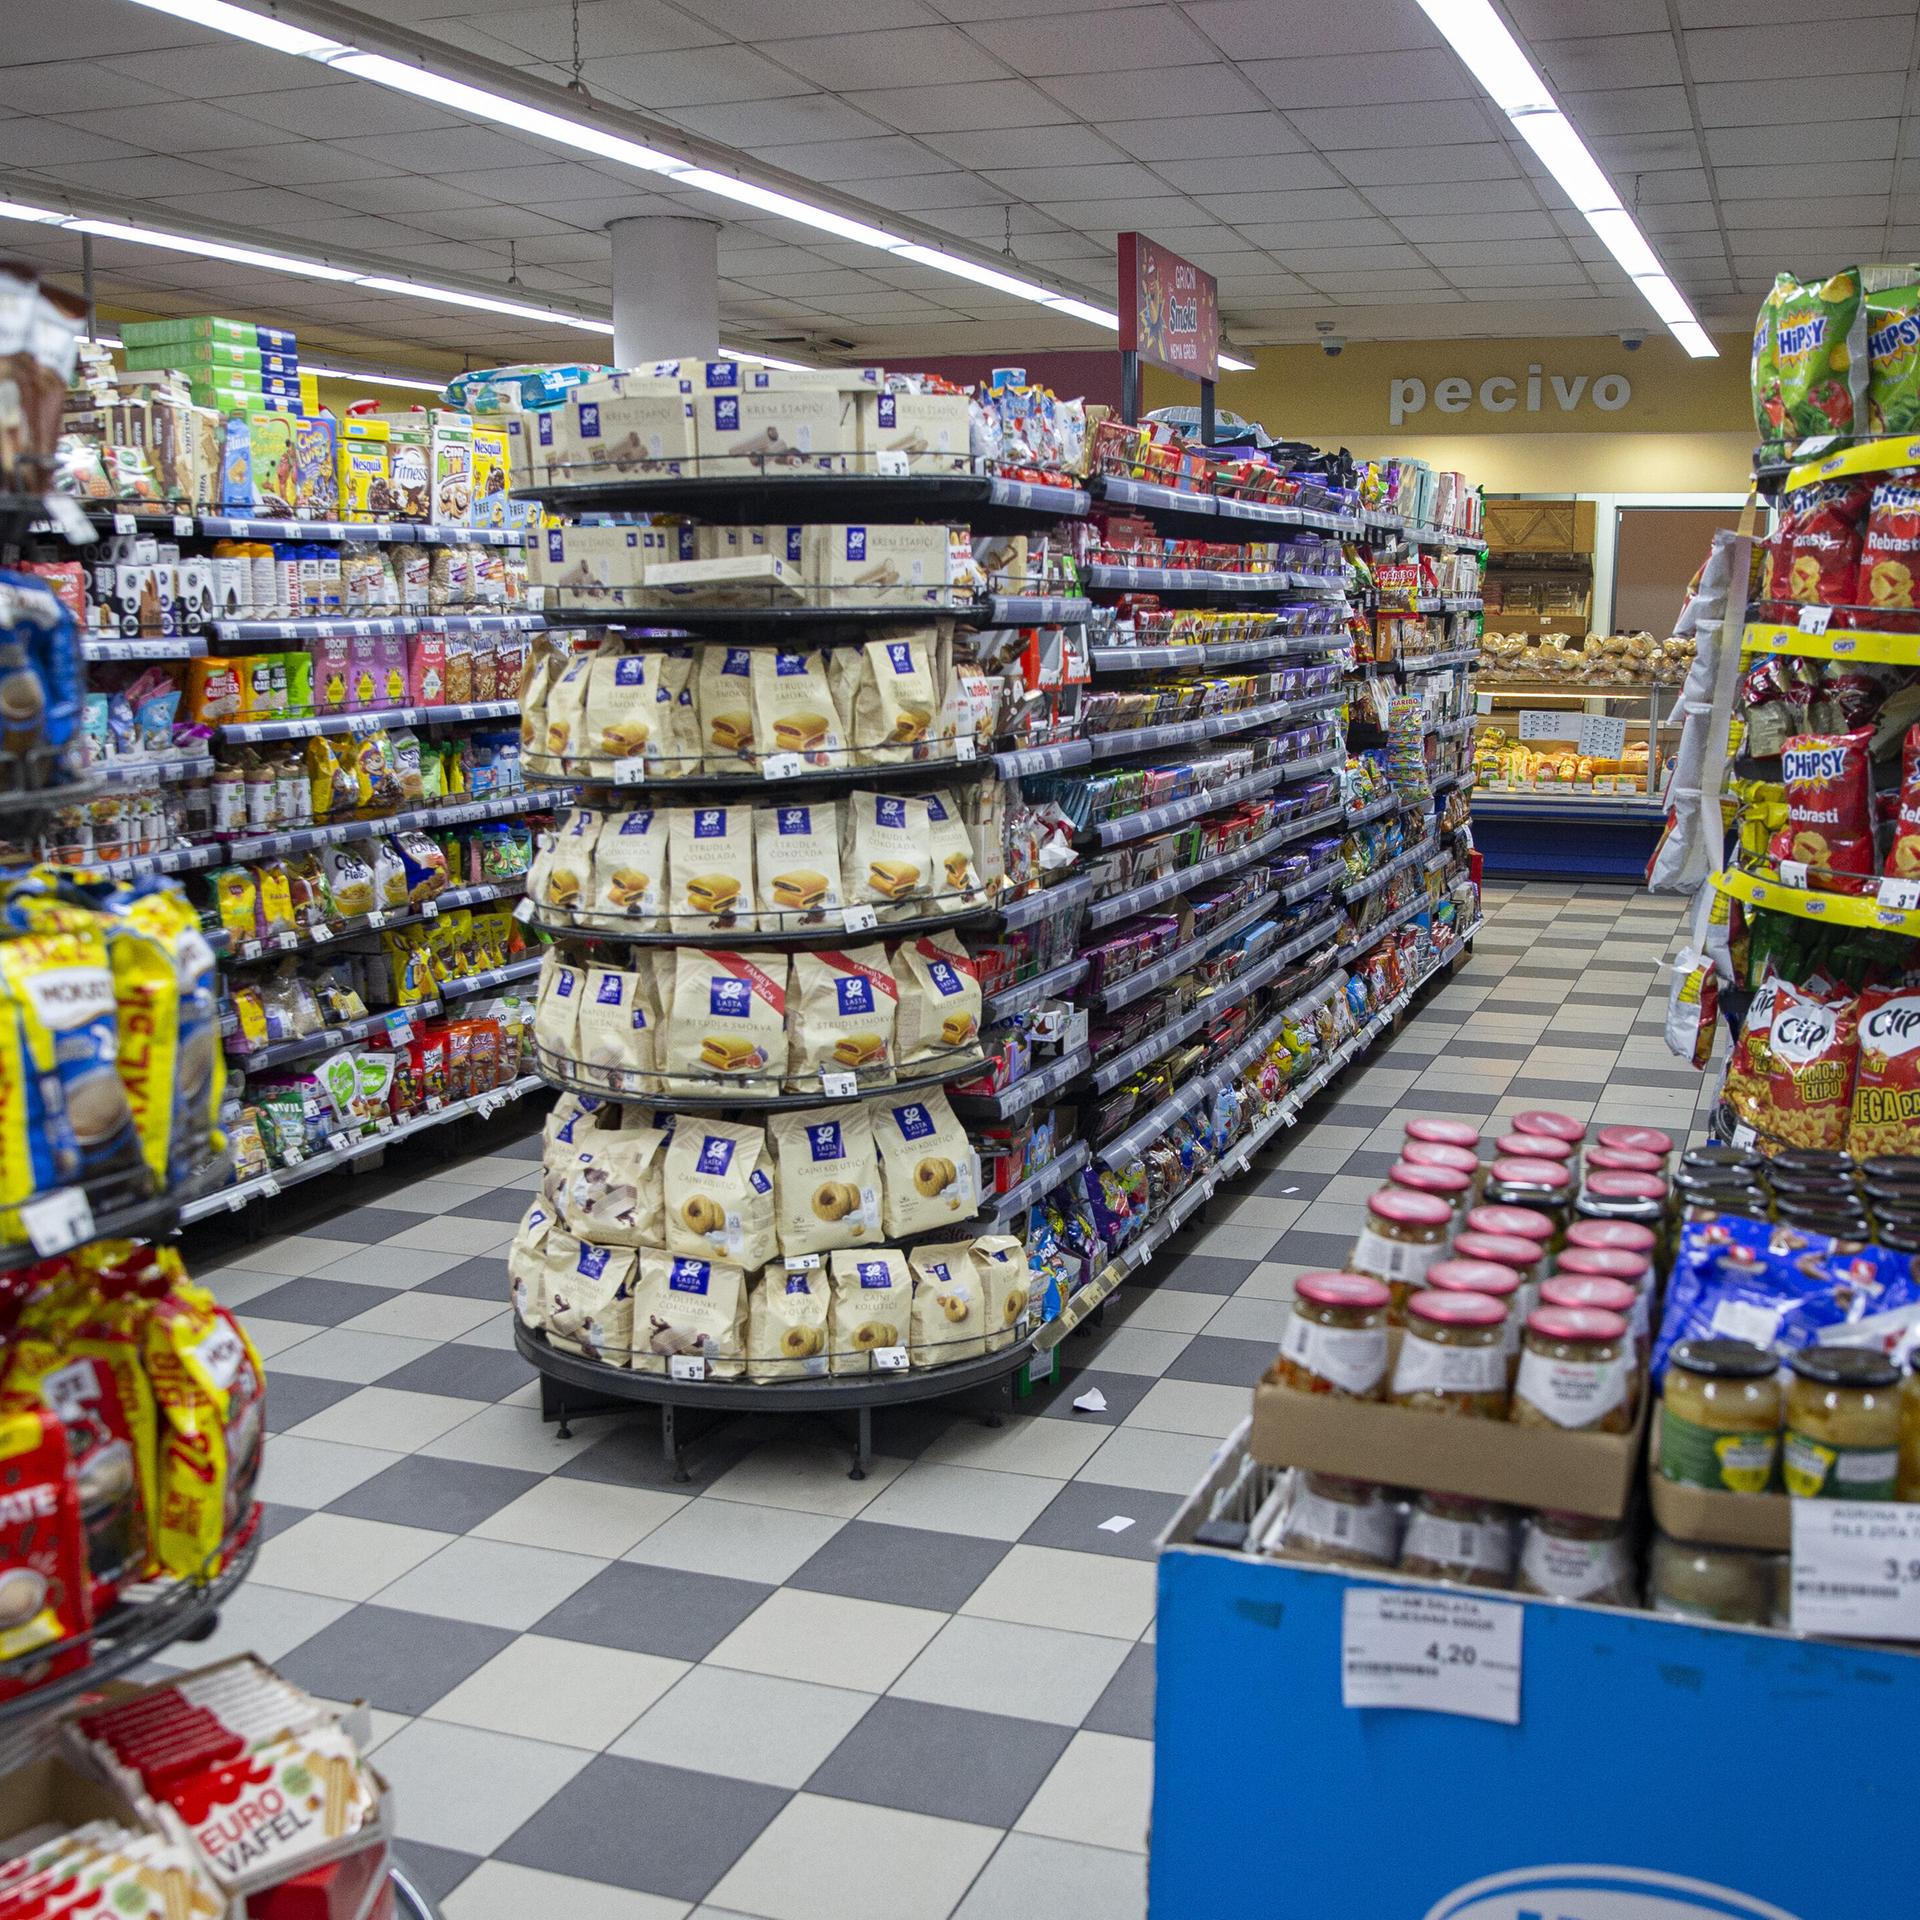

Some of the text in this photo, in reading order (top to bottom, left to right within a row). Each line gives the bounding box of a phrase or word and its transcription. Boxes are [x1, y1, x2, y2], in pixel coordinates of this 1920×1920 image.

[1169, 295, 1198, 334] Smoki
[1776, 316, 1827, 356] HiPSY
[1867, 313, 1920, 359] HiPSY
[1389, 363, 1632, 426] pecivo
[473, 438, 502, 456] Nesquik
[352, 458, 383, 473] Nesquik
[391, 456, 429, 483] Fitness
[474, 501, 490, 516] FREE
[509, 503, 524, 517] FREE
[1380, 570, 1416, 582] HARIBO
[324, 638, 348, 650] BOOM
[424, 643, 441, 654] BOX
[328, 649, 345, 660] BOX
[1391, 697, 1419, 708] HARIBO
[1783, 748, 1846, 782] CHiPSY
[743, 963, 771, 989] FAMILY
[852, 963, 884, 980] FAMILY
[754, 983, 777, 1005] PACK
[871, 976, 892, 994] PACK
[716, 999, 742, 1008] LASTA
[844, 997, 867, 1007] LASTA
[1804, 1081, 1840, 1101] EKIPU
[1900, 1090, 1920, 1119] PA
[905, 1121, 927, 1133] LASTA
[816, 1143, 838, 1152] LASTA
[676, 1276, 702, 1286] LASTA
[1884, 1557, 1920, 1584] 3.9
[197, 1787, 285, 1856] EURO
[214, 1808, 313, 1874] VAFEL
